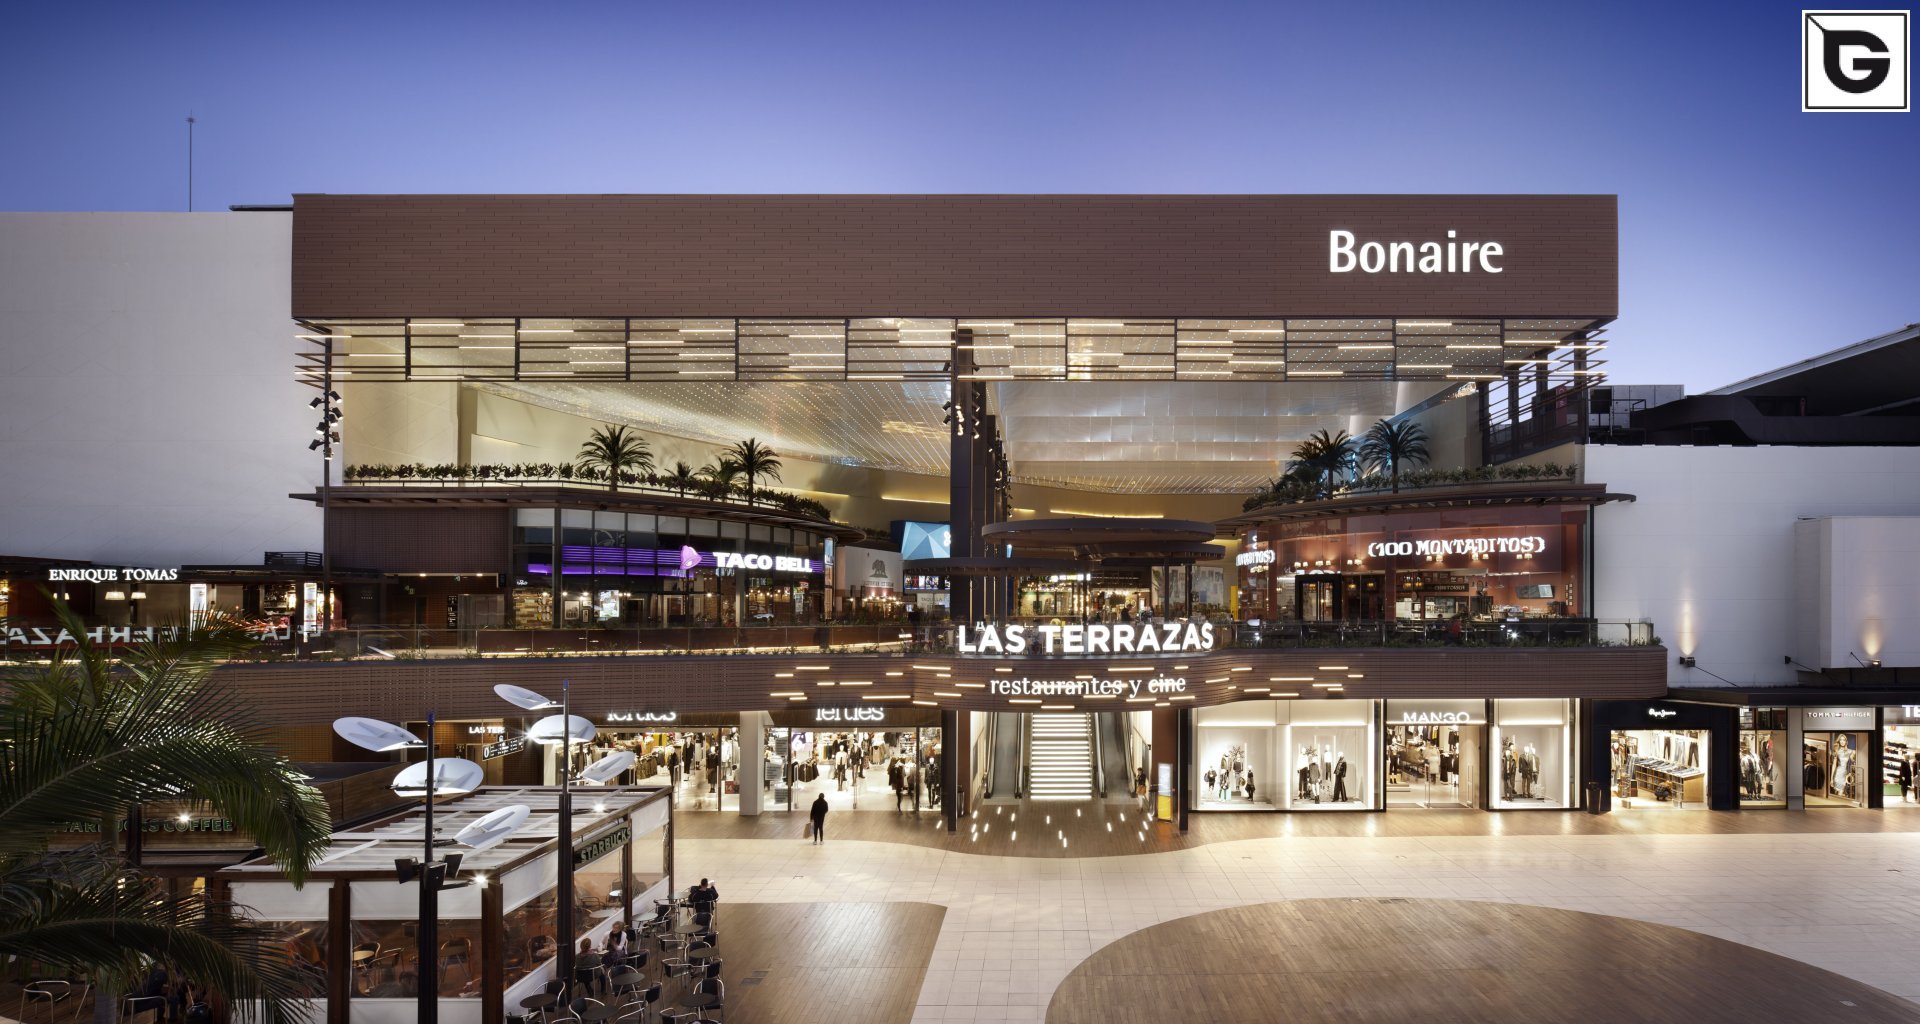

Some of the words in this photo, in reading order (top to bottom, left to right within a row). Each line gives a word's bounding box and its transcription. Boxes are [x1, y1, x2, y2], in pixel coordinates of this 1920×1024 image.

[1329, 230, 1504, 273] Bonaire
[712, 551, 773, 570] TACO
[775, 555, 813, 573] BELL
[48, 568, 118, 583] ENRIQUE
[122, 568, 178, 581] TOMAS
[957, 624, 1027, 654] LAS
[1038, 622, 1214, 654] TERRAZAS
[990, 677, 1123, 696] restaurantes
[1128, 679, 1143, 699] y
[1148, 673, 1187, 694] cine
[1402, 711, 1471, 724] MANGO
[469, 726, 486, 734] LAS
[163, 818, 233, 833] COFFEE
[581, 826, 632, 861] STARBUCKS
